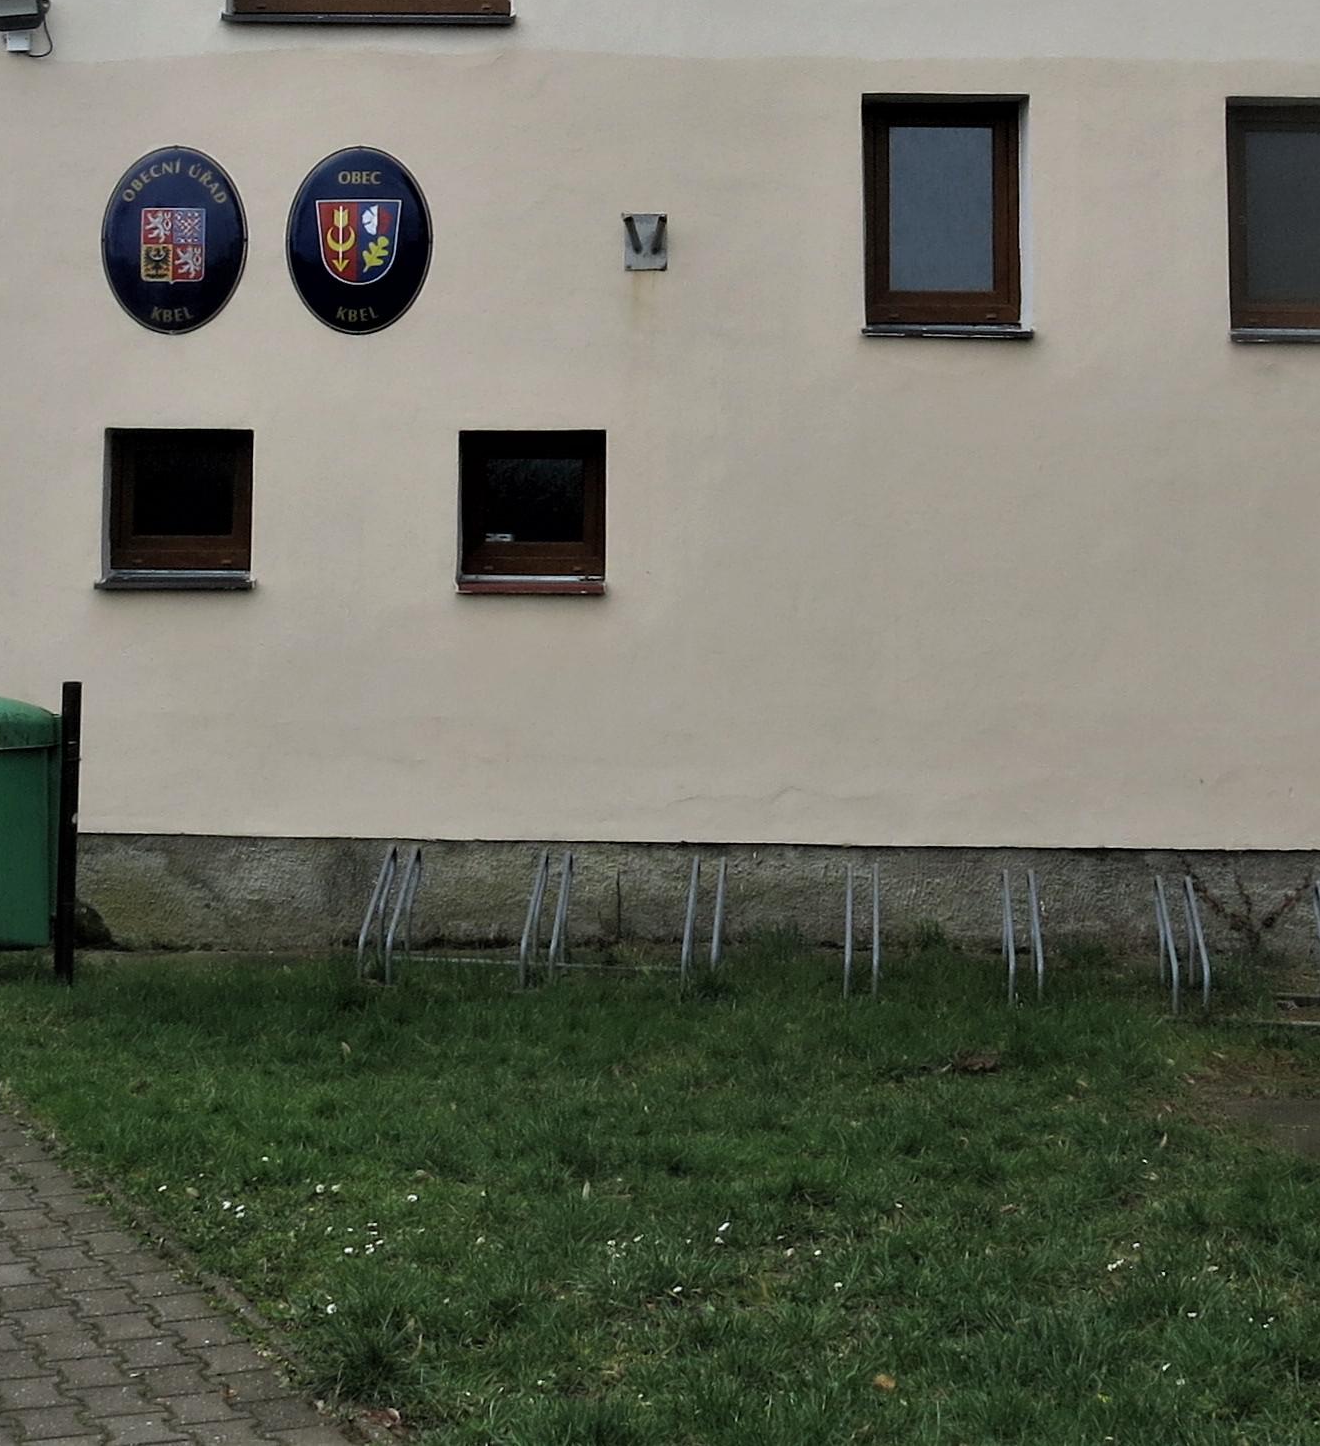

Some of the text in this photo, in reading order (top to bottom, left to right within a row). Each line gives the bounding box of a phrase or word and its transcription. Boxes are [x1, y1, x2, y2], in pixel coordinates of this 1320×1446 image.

[122, 158, 228, 204] OBECNÍ ÚŘAD
[337, 170, 382, 186] OBEC
[150, 305, 195, 323] KBEL
[336, 305, 380, 323] KBEL
